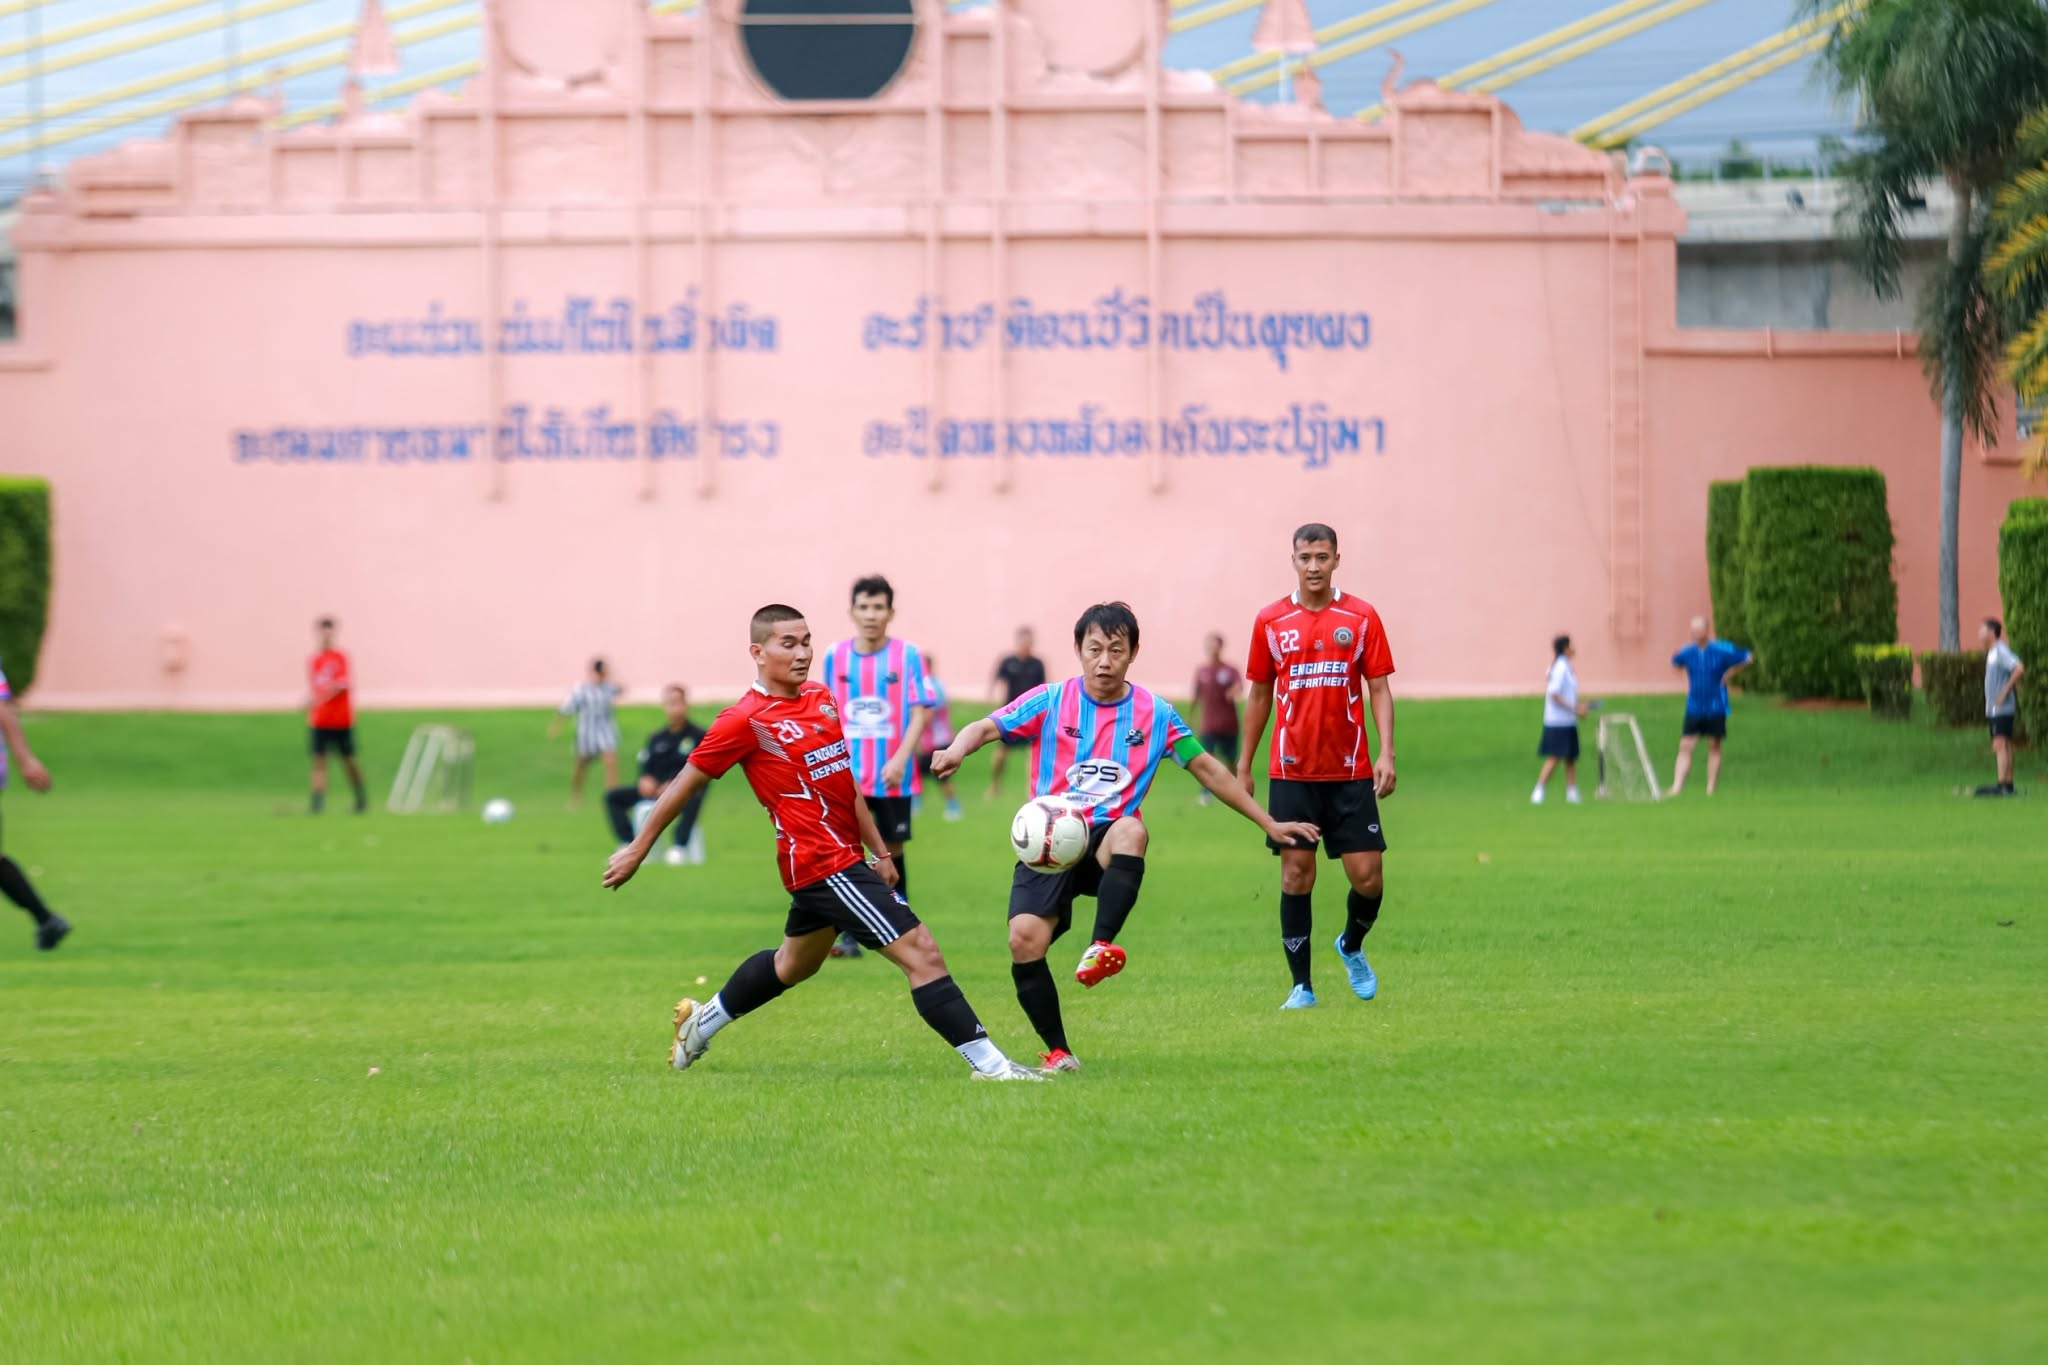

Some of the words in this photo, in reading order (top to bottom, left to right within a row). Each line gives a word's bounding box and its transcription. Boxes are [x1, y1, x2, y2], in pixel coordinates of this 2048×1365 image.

[1280, 629, 1299, 653] 22
[1290, 661, 1348, 677] ENGINEER
[1289, 677, 1349, 690] DEPARTMENT
[771, 719, 804, 744] 20
[1079, 765, 1119, 783] PS
